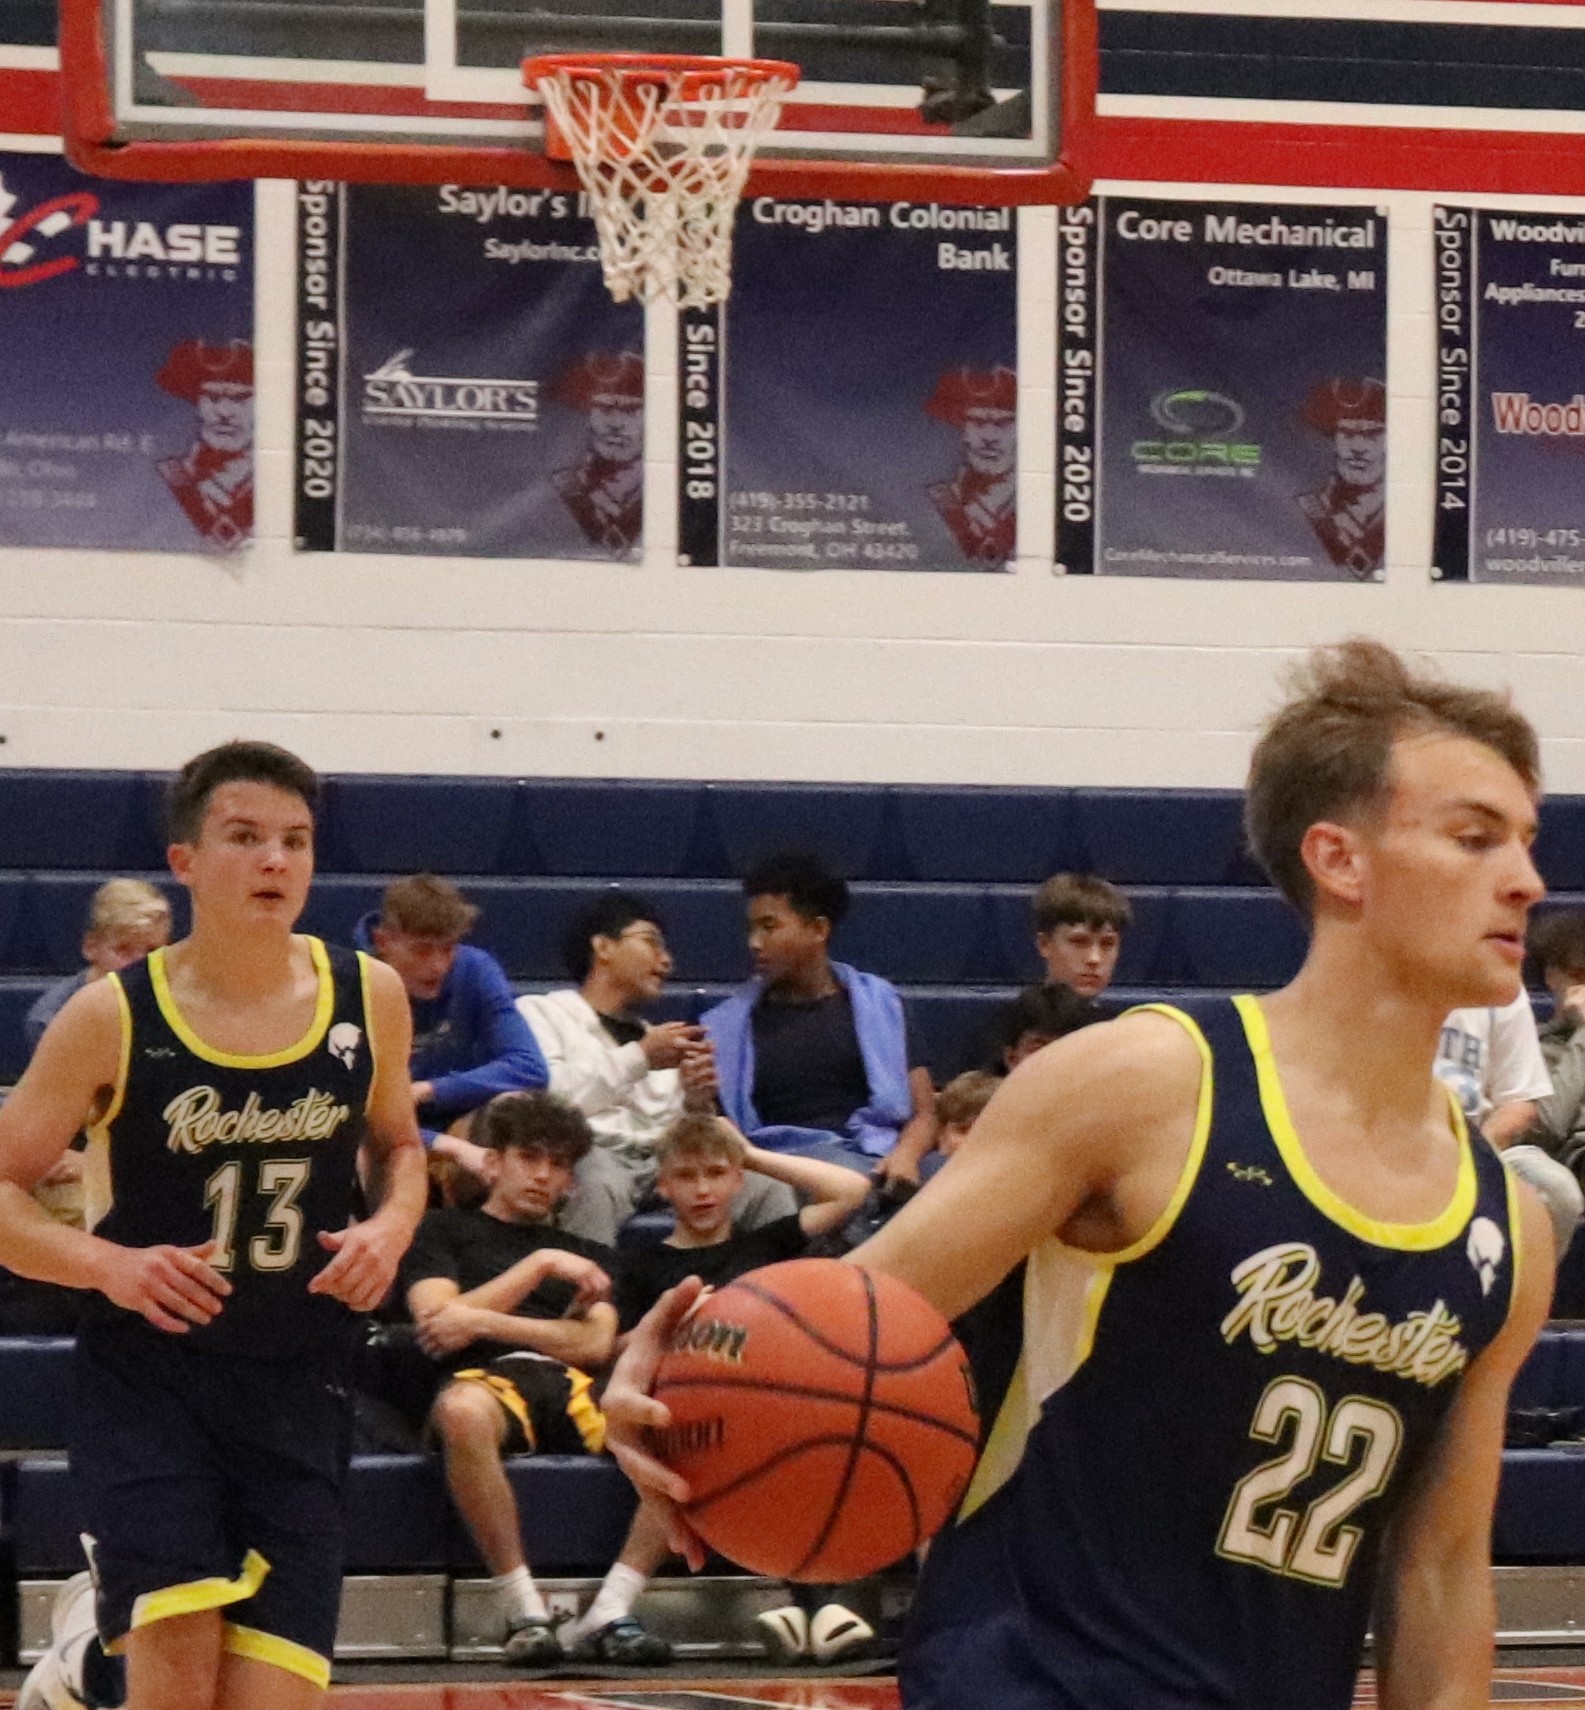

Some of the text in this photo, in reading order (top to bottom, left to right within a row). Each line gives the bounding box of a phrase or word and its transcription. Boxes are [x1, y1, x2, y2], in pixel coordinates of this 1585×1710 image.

[439, 185, 565, 220] Saylor's
[752, 197, 1010, 235] Croghan Colonial
[1117, 212, 1375, 249] Core Mechanical
[937, 243, 1010, 271] Bank
[1208, 266, 1375, 291] Ottawa Lake, MI
[304, 319, 334, 406] Since
[364, 382, 538, 413] SAYLOR'S
[1060, 205, 1093, 522] Sponsor Since 2020
[1437, 212, 1468, 510] Sponsor Since 2014
[687, 324, 714, 499] Since 2018
[303, 420, 334, 499] 2020
[1130, 440, 1262, 464] CORE
[163, 1084, 349, 1154] Rochester
[202, 1157, 311, 1272] 13
[1220, 1242, 1469, 1388] Rochester
[1215, 1374, 1405, 1589] 22
